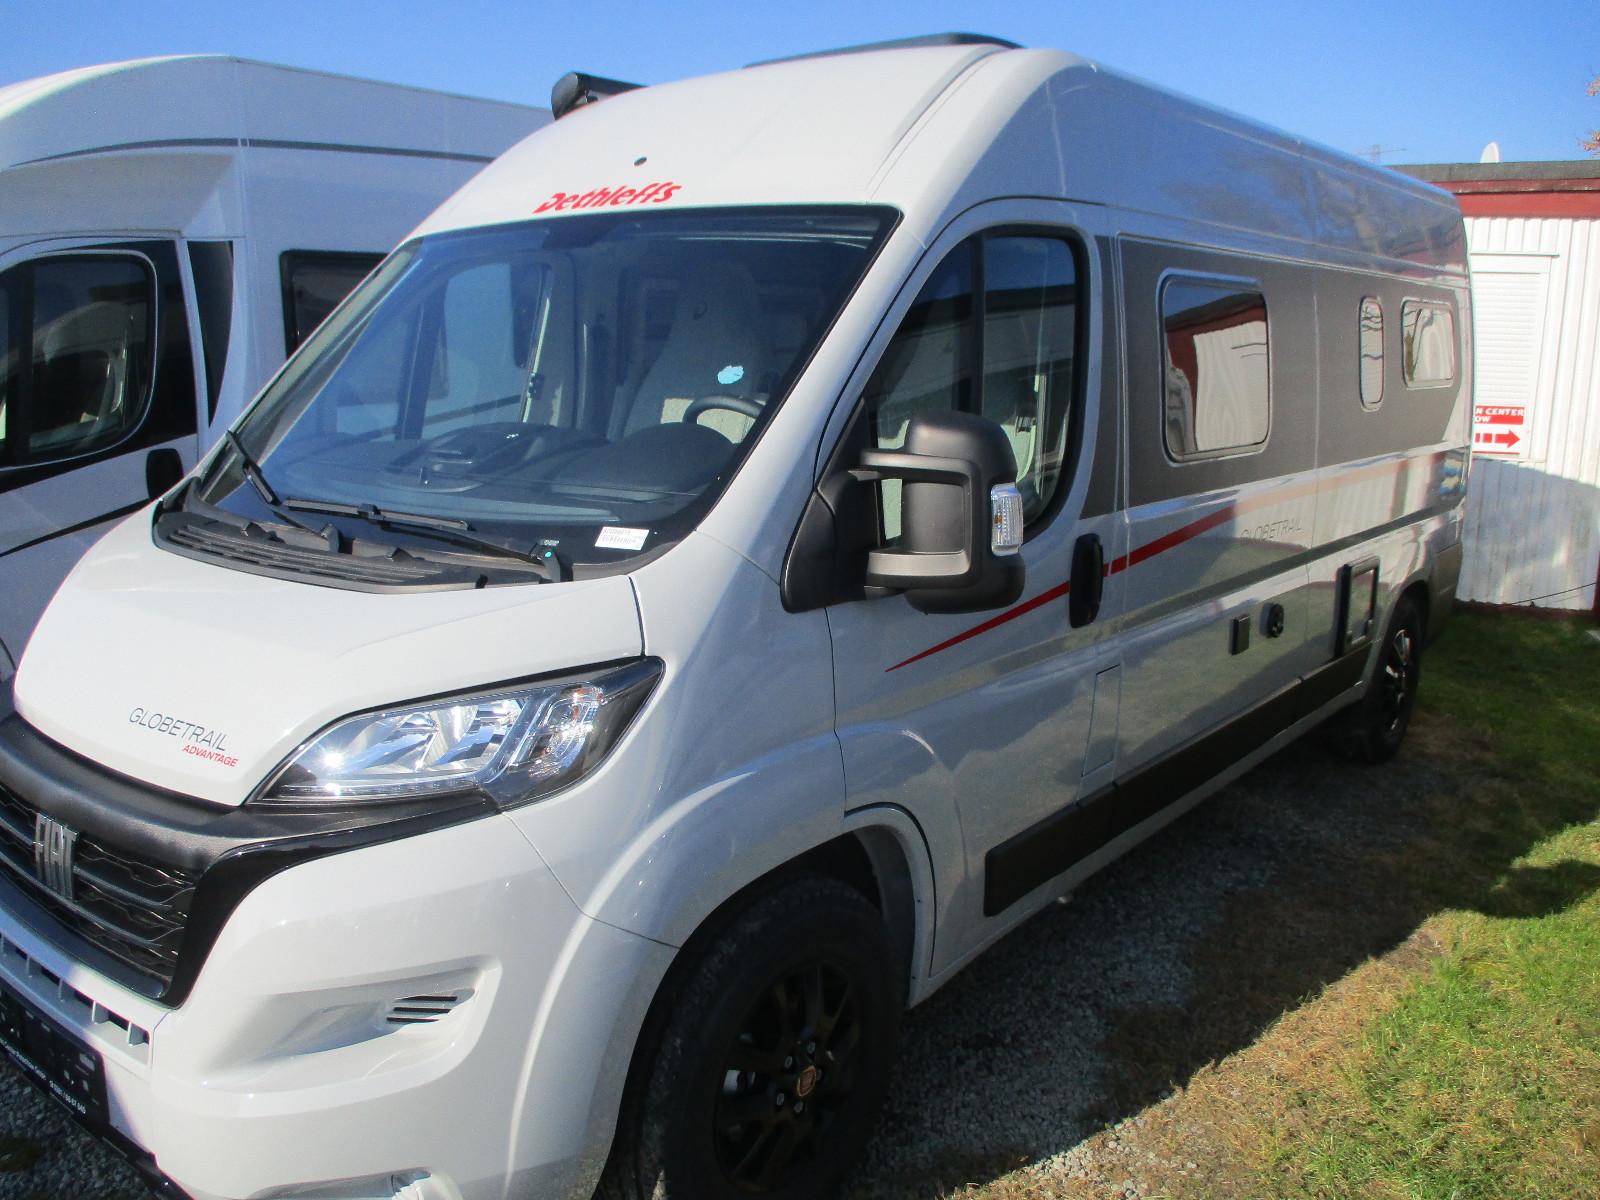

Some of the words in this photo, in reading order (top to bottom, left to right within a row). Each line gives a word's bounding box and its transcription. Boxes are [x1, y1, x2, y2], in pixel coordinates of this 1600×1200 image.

[533, 181, 682, 214] Dethleffs
[1485, 408, 1524, 417] CENTER
[129, 707, 228, 751] GLOBETRAIL
[182, 744, 238, 767] ADVANTAGE
[34, 812, 78, 899] FIAT
